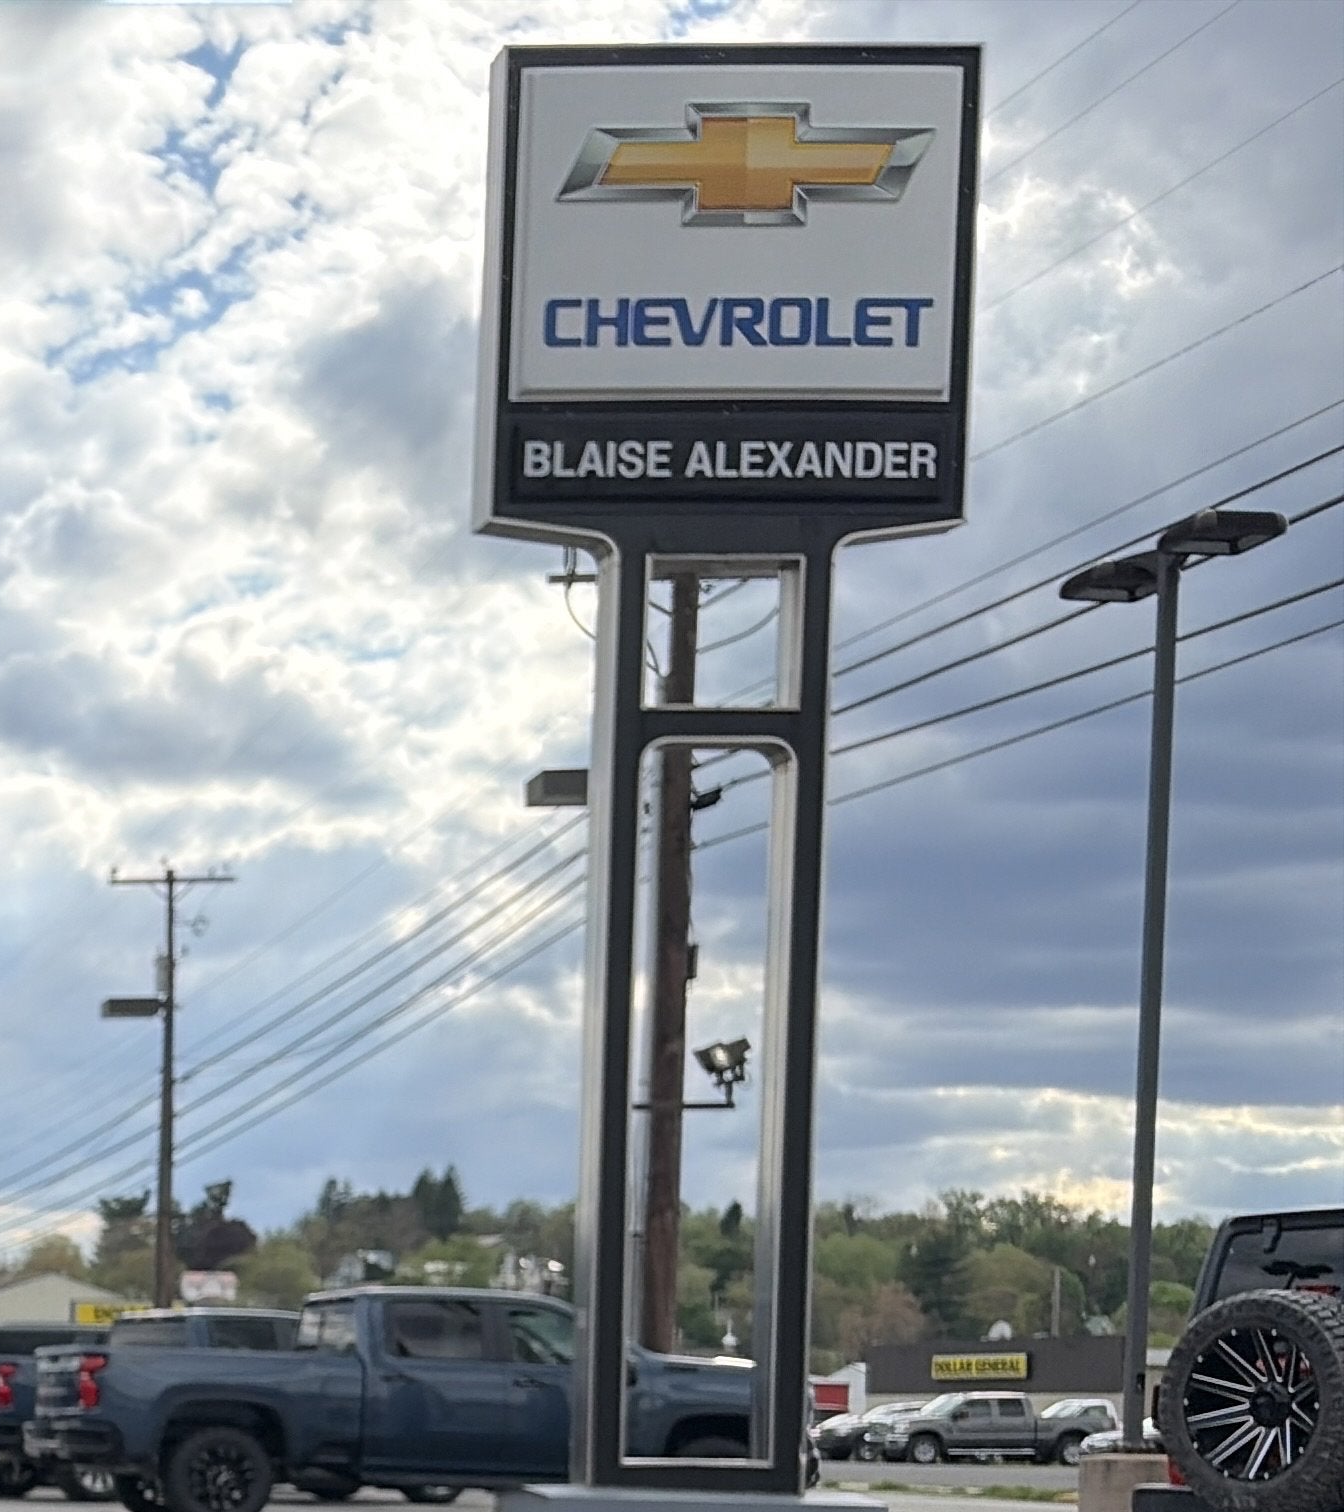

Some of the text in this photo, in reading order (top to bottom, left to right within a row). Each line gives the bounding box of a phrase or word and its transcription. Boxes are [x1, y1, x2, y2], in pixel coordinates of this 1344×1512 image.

[543, 297, 934, 347] CHEVROLET
[522, 439, 938, 479] BLAISE ALEXANDER
